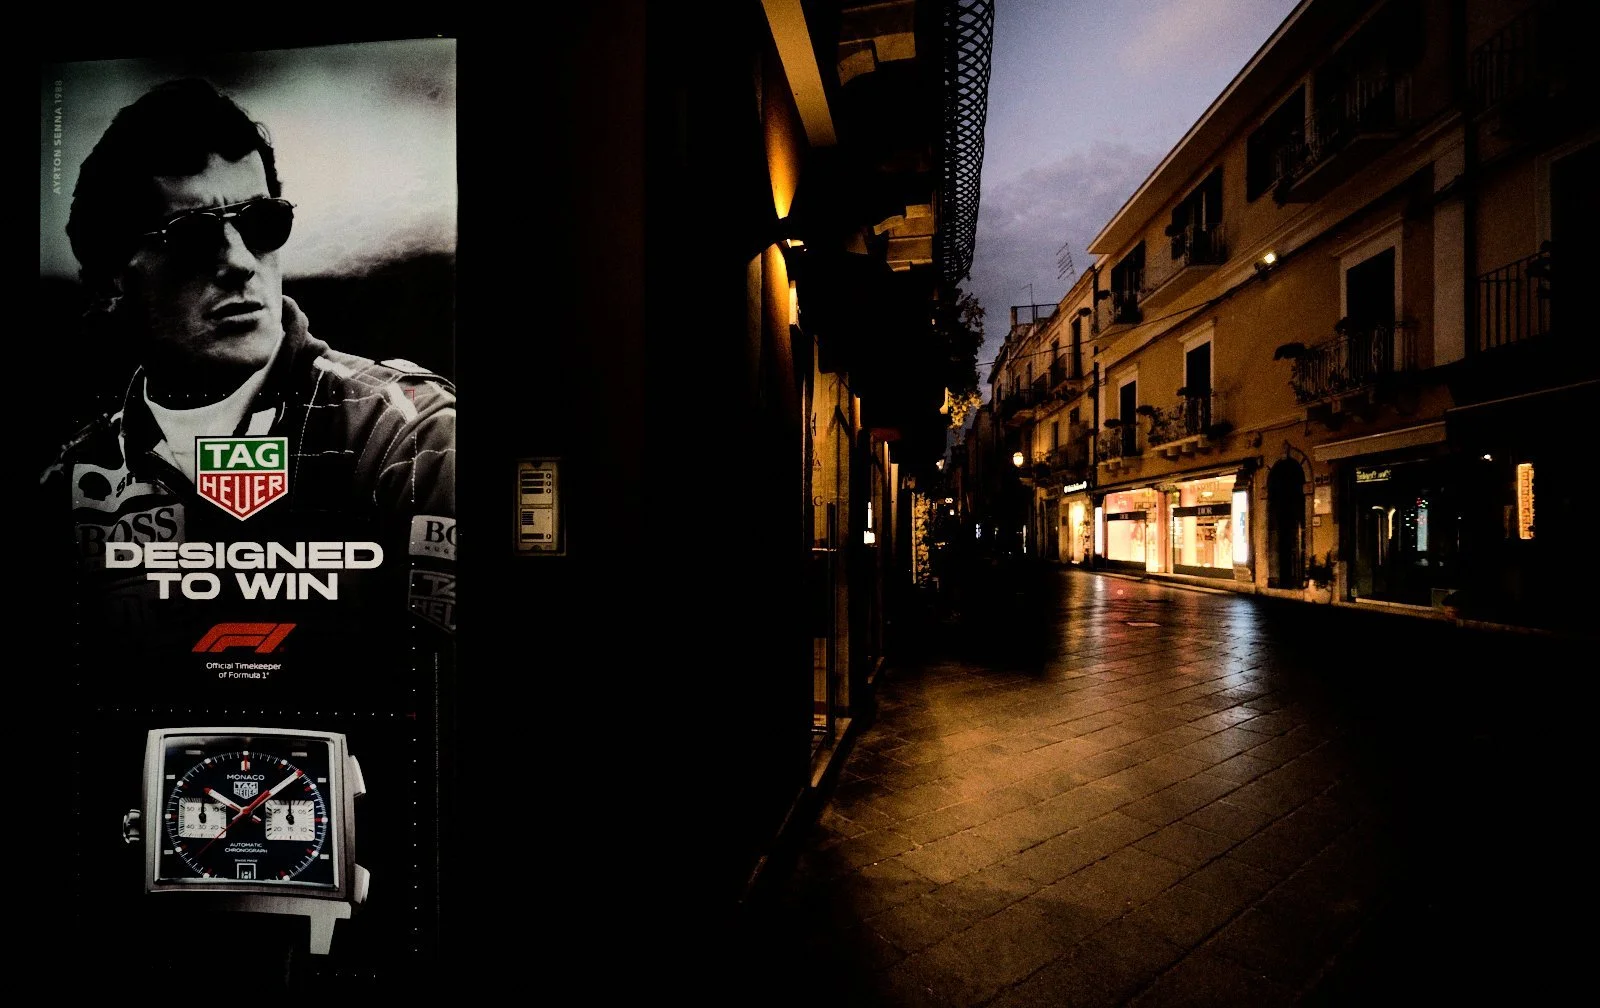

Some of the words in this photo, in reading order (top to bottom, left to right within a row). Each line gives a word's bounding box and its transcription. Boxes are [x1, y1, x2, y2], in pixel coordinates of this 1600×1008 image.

[54, 80, 63, 104] 1988
[54, 107, 62, 146] SENNA
[53, 150, 61, 194] AYRTON
[204, 443, 280, 468] TAG
[202, 475, 283, 513] HEUER
[105, 541, 384, 569] DESIGNED
[147, 572, 221, 600] TO
[235, 572, 338, 600] WIN
[191, 622, 297, 653] F1
[218, 671, 228, 679] of
[228, 671, 261, 679] Formula
[235, 662, 281, 670] Timekeeper
